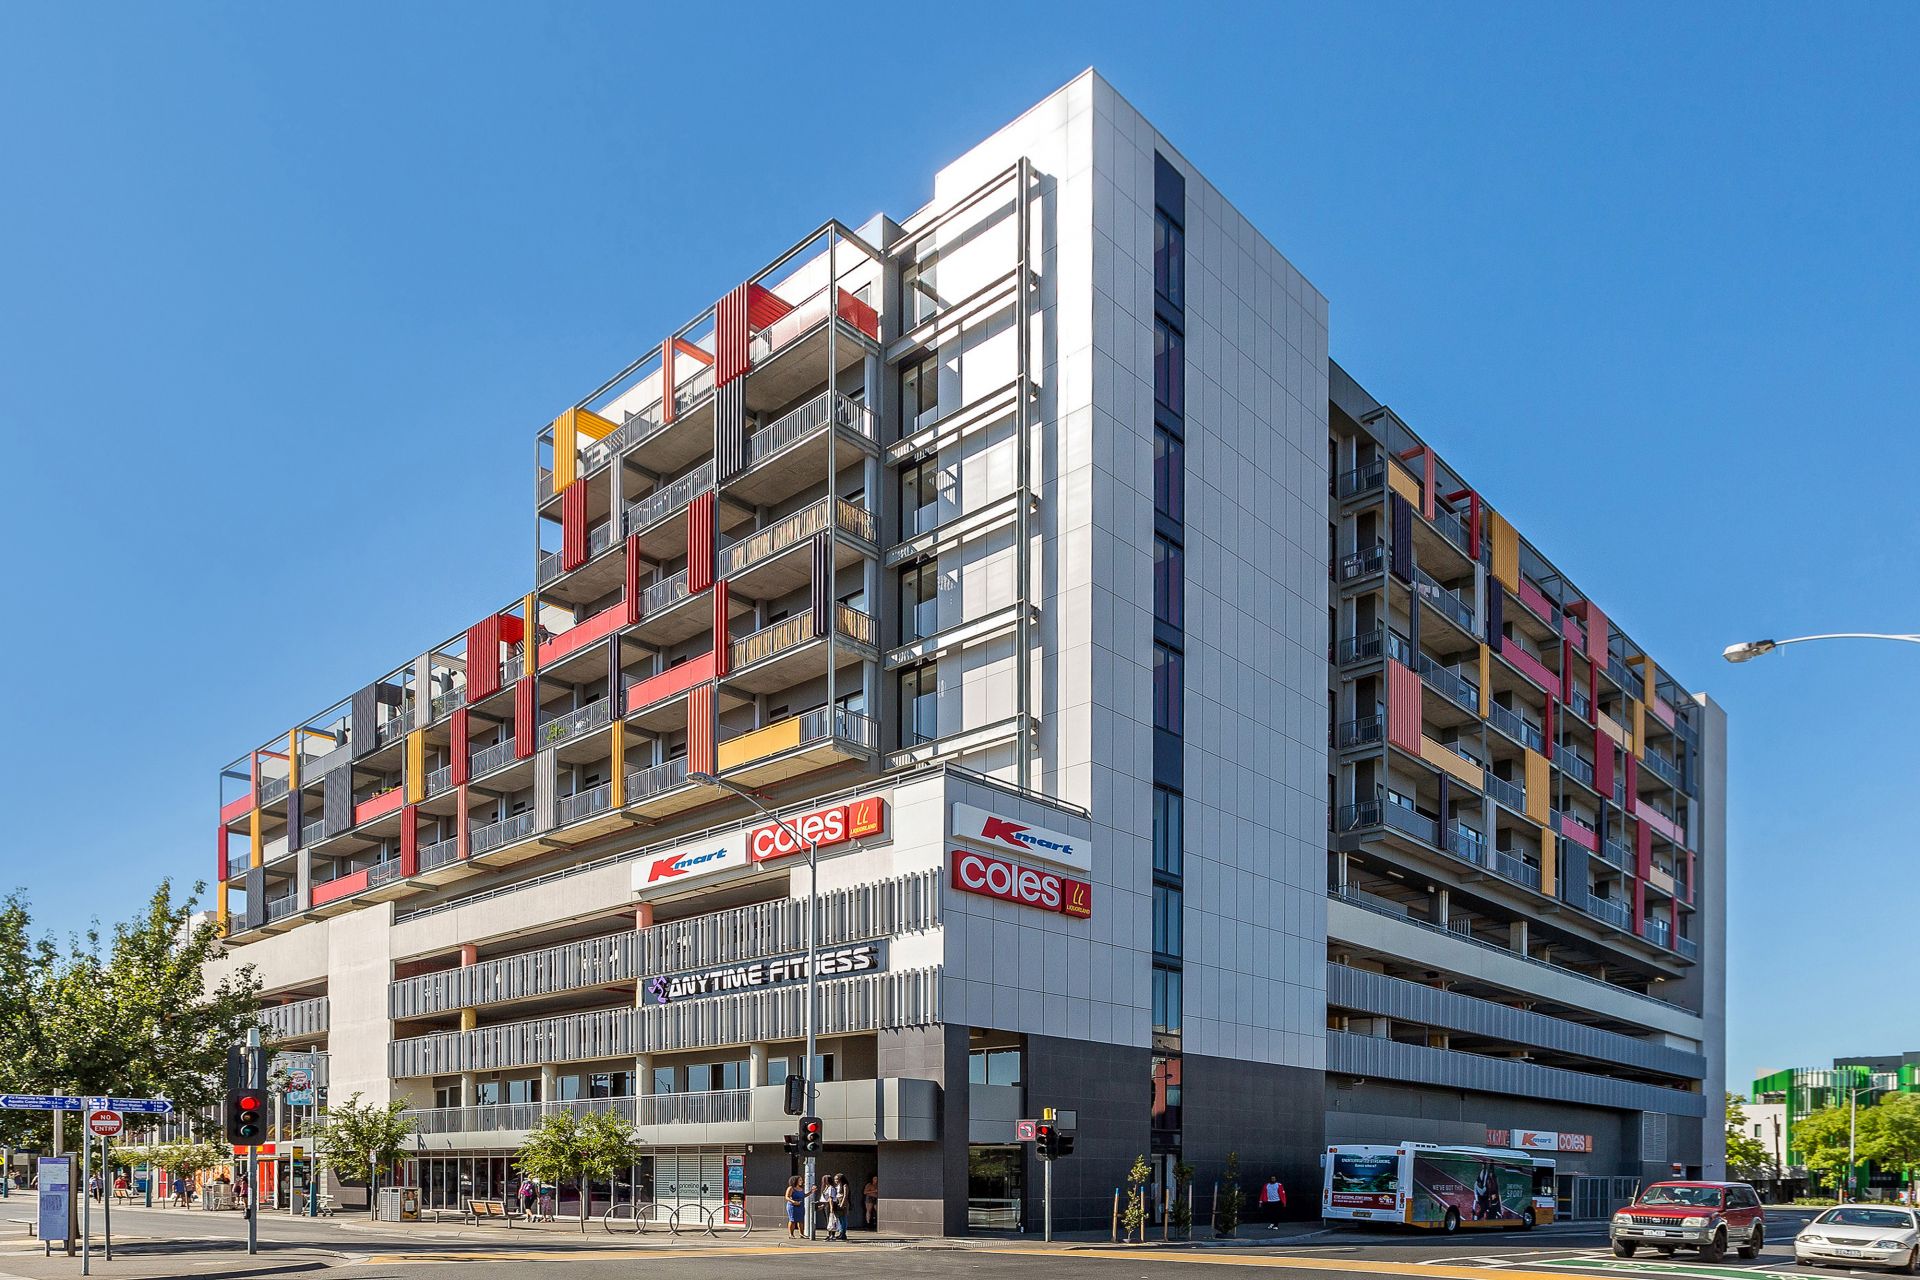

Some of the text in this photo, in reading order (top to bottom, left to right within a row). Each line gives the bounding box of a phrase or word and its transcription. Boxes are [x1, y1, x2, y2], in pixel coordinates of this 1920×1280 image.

[753, 810, 843, 857] coles
[850, 822, 877, 834] LIQUORLAND
[981, 816, 1073, 855] Kmart
[648, 848, 727, 882] Kmart
[960, 856, 1060, 907] coles
[1066, 904, 1091, 915] LIQUORLAND
[668, 946, 873, 997] ANYTIME FITNESS
[1522, 1132, 1552, 1147] Kmart
[1559, 1134, 1585, 1151] coles
